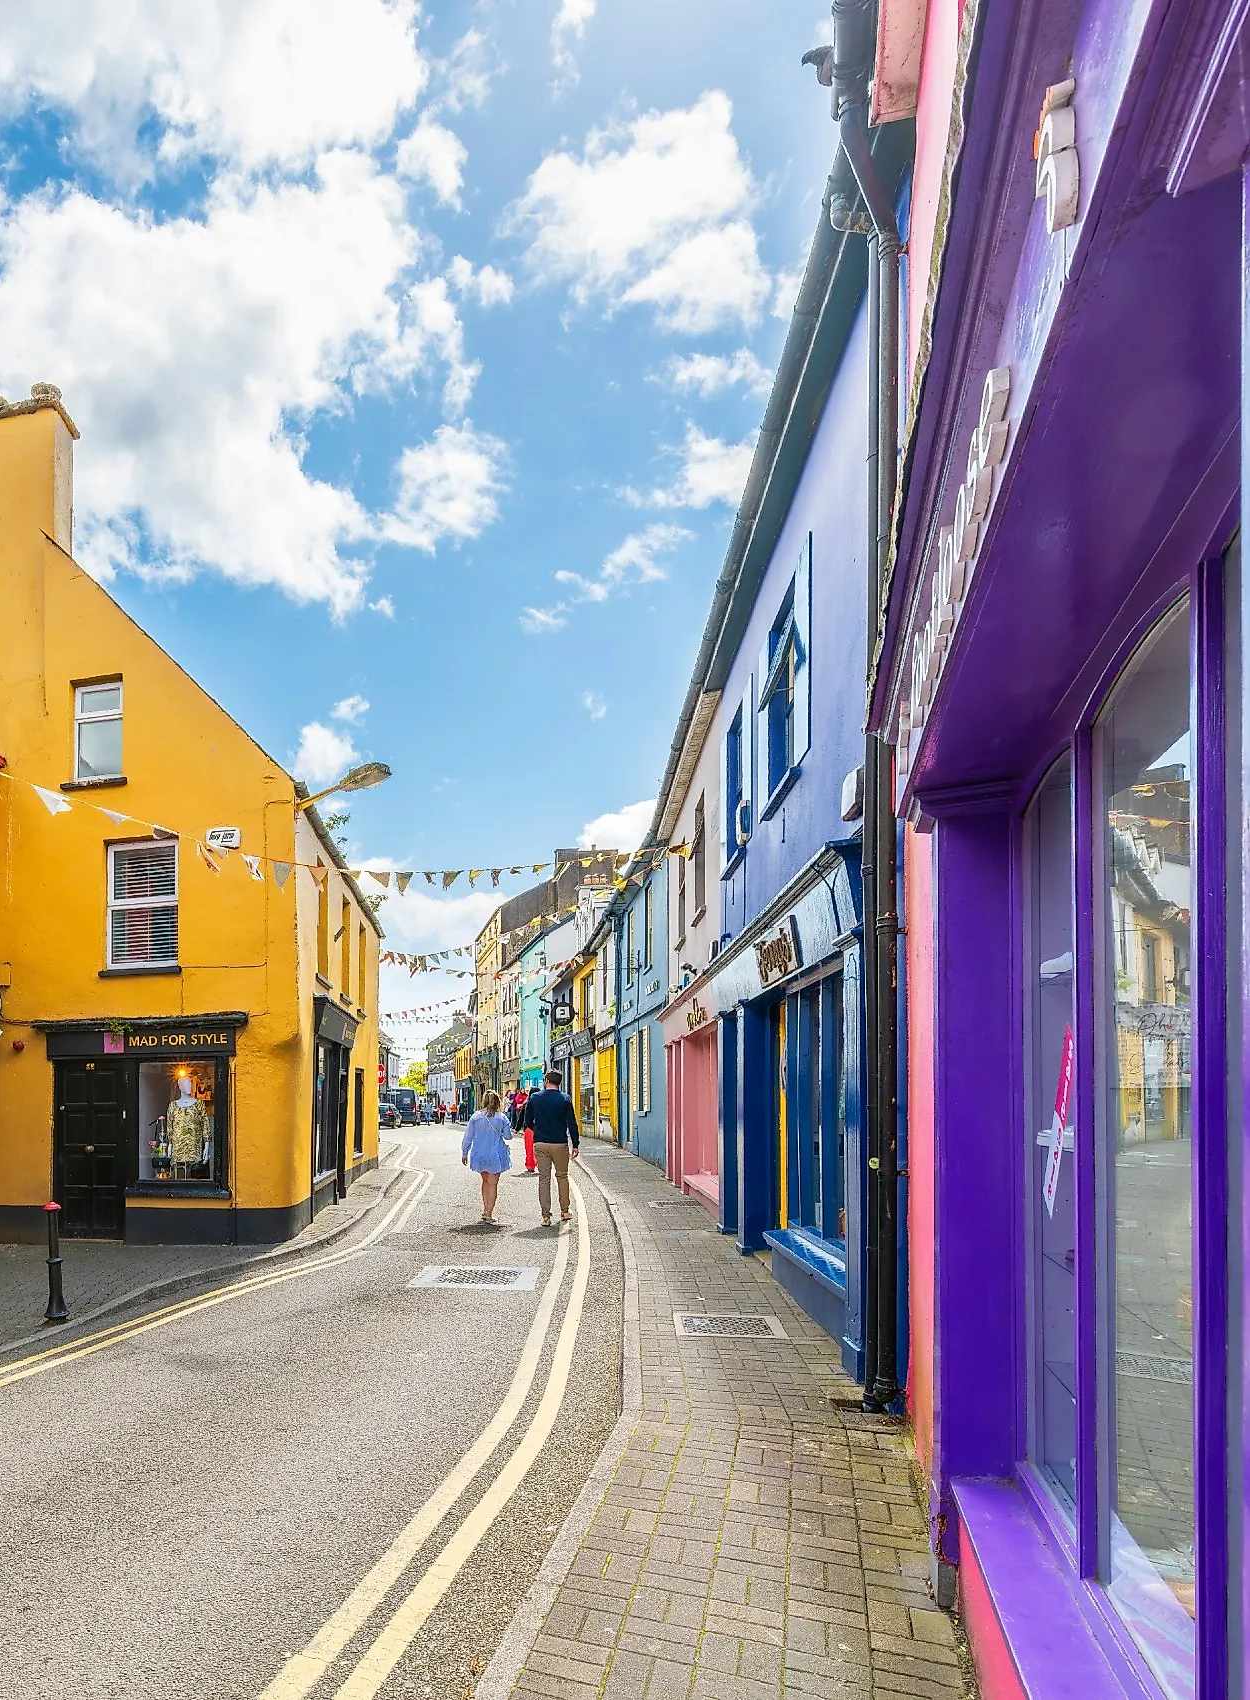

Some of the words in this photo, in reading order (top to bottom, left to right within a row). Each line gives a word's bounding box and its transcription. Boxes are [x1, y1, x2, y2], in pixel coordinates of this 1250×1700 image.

[128, 1035, 157, 1047] MAD
[161, 1034, 187, 1046] FOR
[191, 1033, 228, 1046] STYLE
